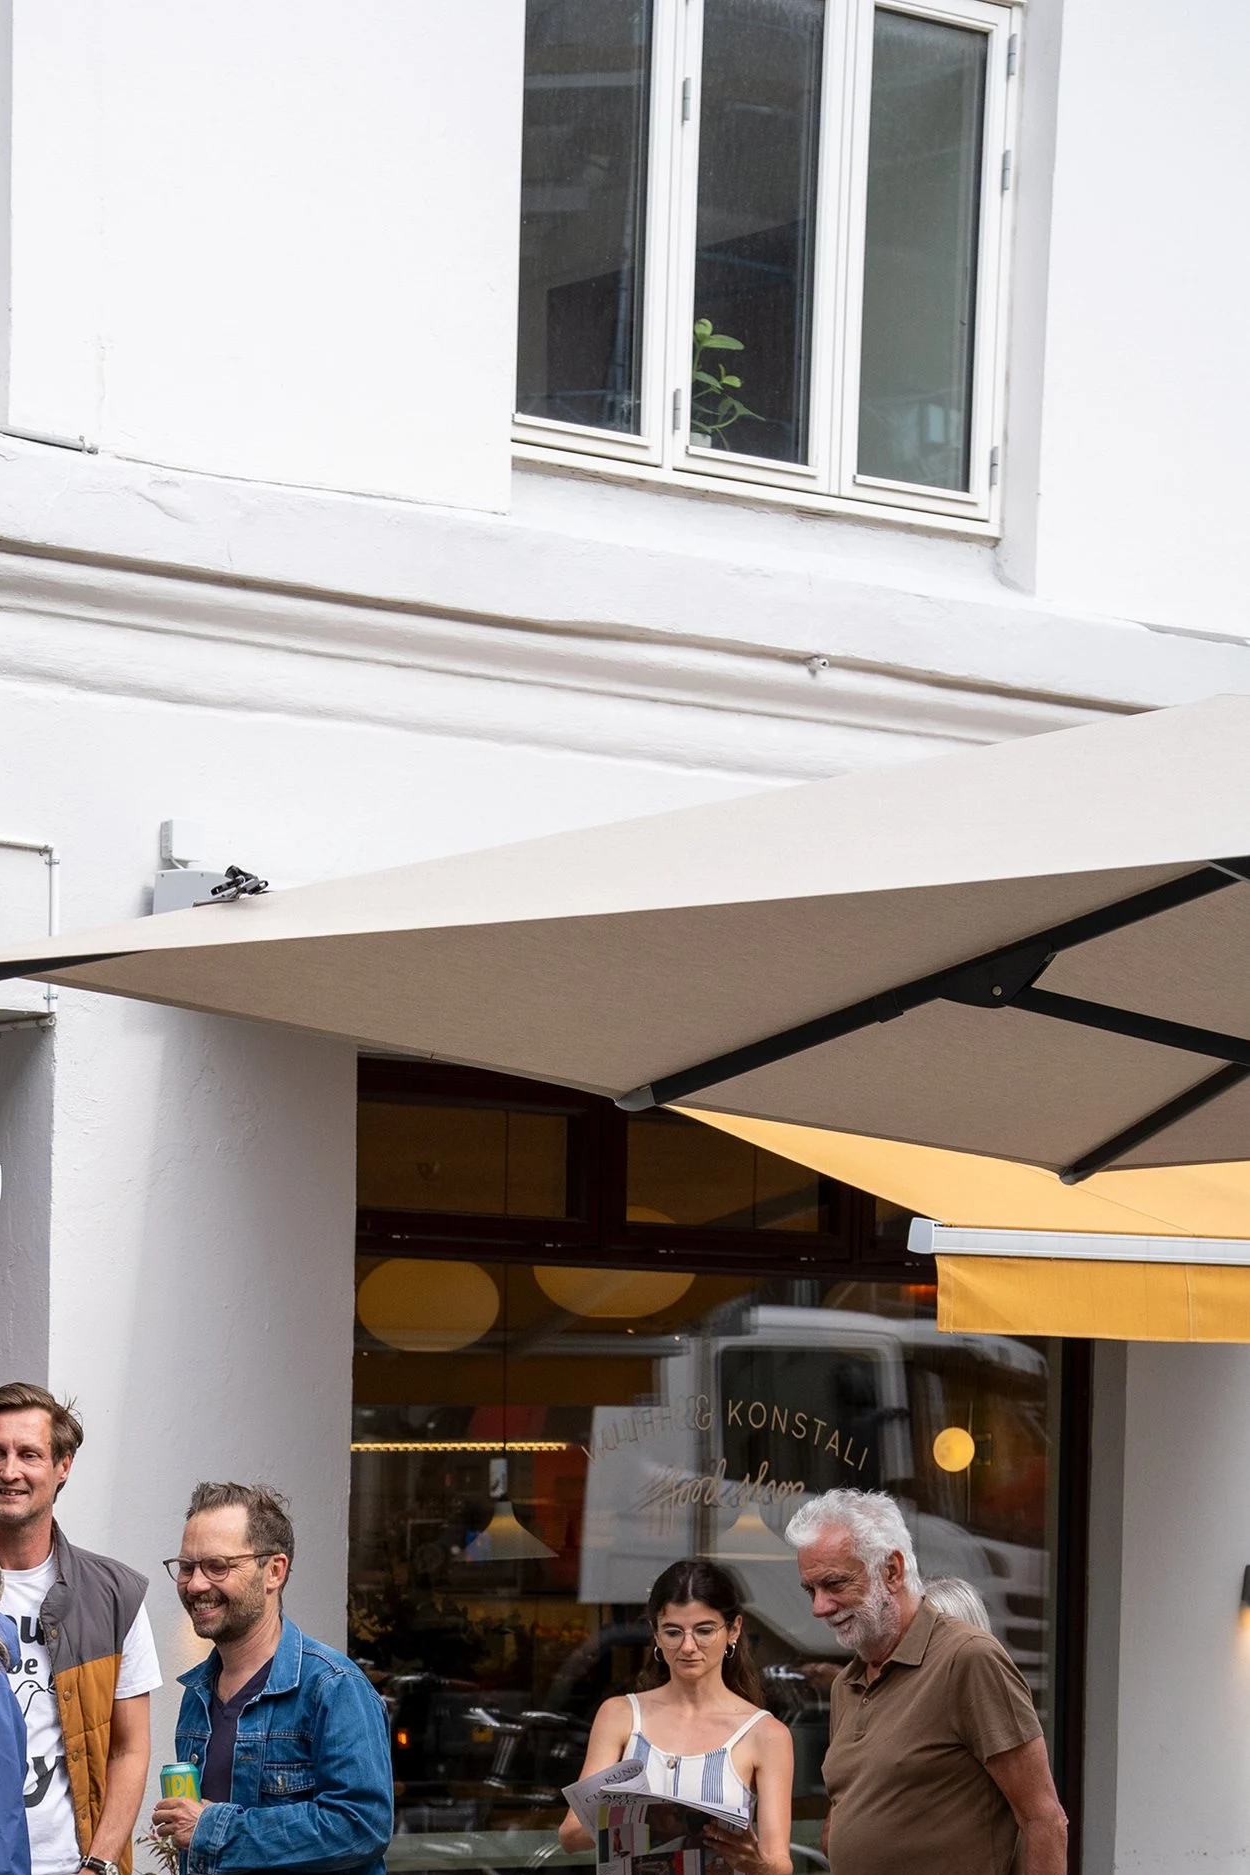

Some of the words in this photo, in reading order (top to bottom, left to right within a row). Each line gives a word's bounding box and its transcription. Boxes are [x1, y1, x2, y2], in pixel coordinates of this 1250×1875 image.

[694, 1394, 714, 1431] &
[727, 1399, 869, 1472] KONSTALI
[164, 1773, 199, 1802] IPA
